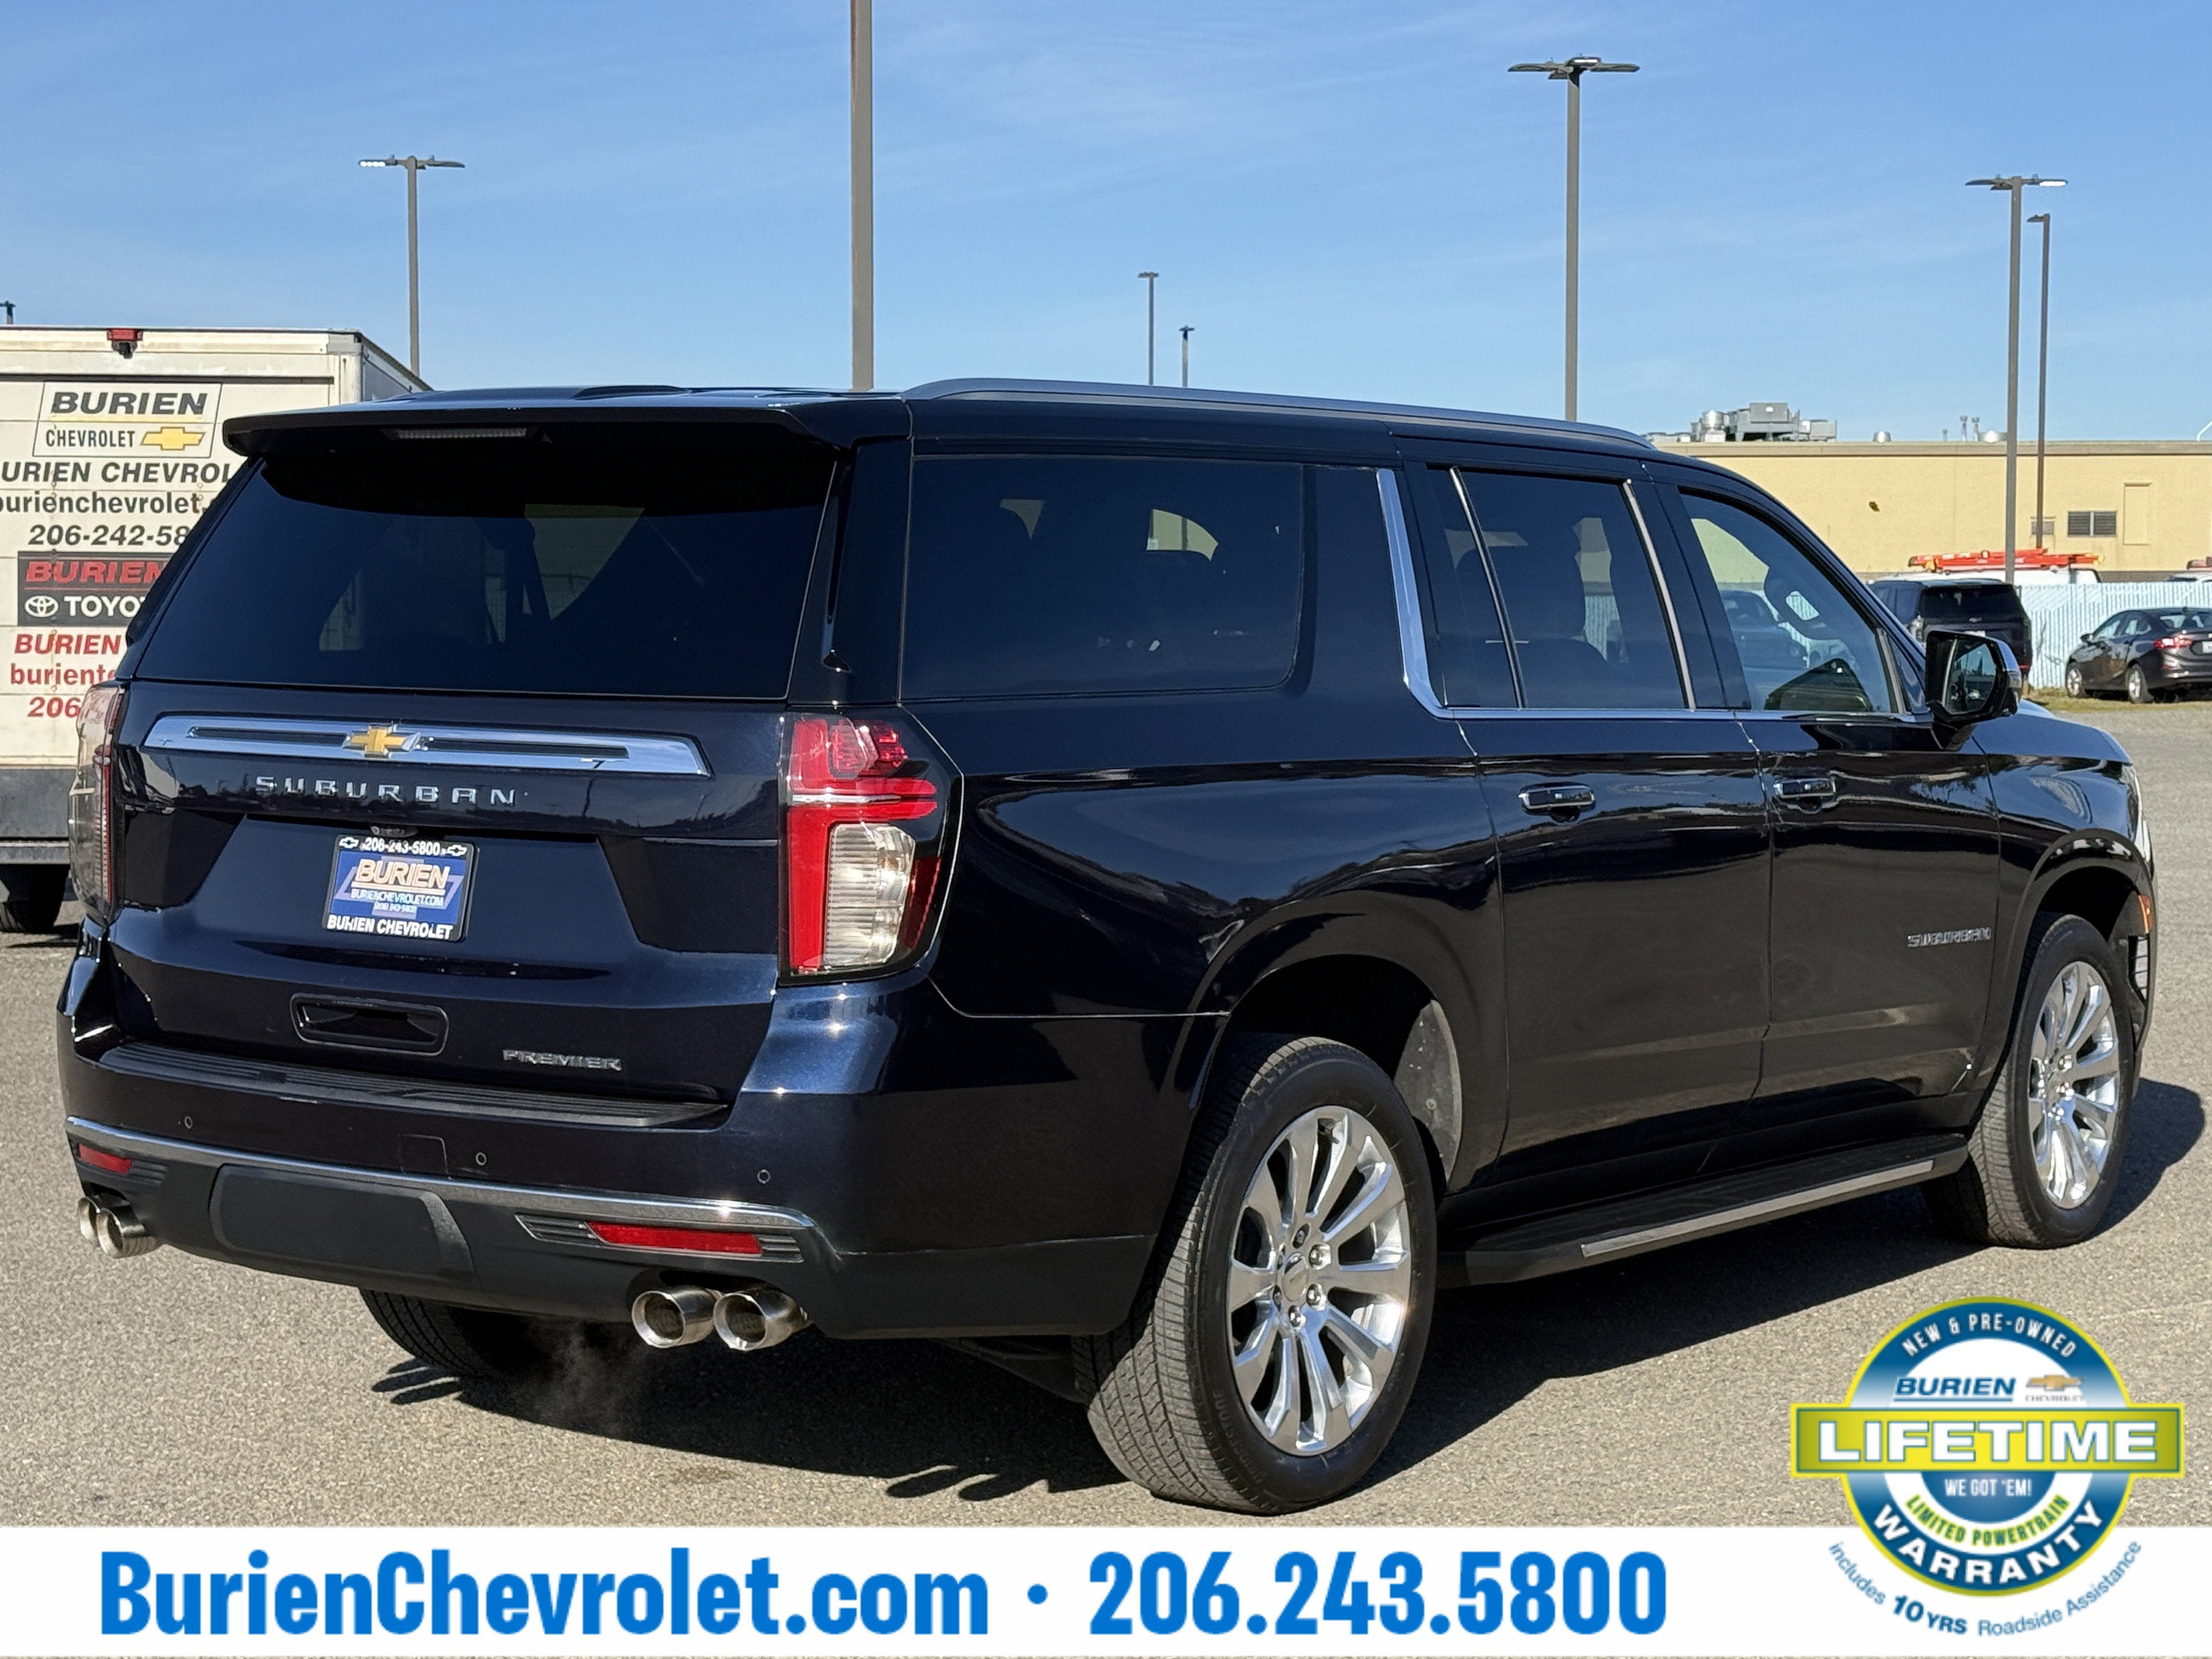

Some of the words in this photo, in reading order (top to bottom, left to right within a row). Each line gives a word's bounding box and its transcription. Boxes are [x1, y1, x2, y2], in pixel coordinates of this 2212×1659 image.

[52, 392, 208, 415] BURIEN
[46, 430, 136, 448] CHEVROLET
[0, 490, 215, 514] urienchevrolet.
[64, 595, 145, 618] TOYO
[14, 634, 122, 654] BURIEN
[256, 776, 516, 807] SUBURBAN
[355, 858, 451, 889] BURIEN
[351, 889, 444, 907] BURIENCHEVROLET.COM
[327, 915, 375, 933] BURIEN
[377, 919, 453, 940] CHEVROLET
[1908, 927, 1991, 947] SUBURBAN
[503, 1048, 622, 1071] PREMIER
